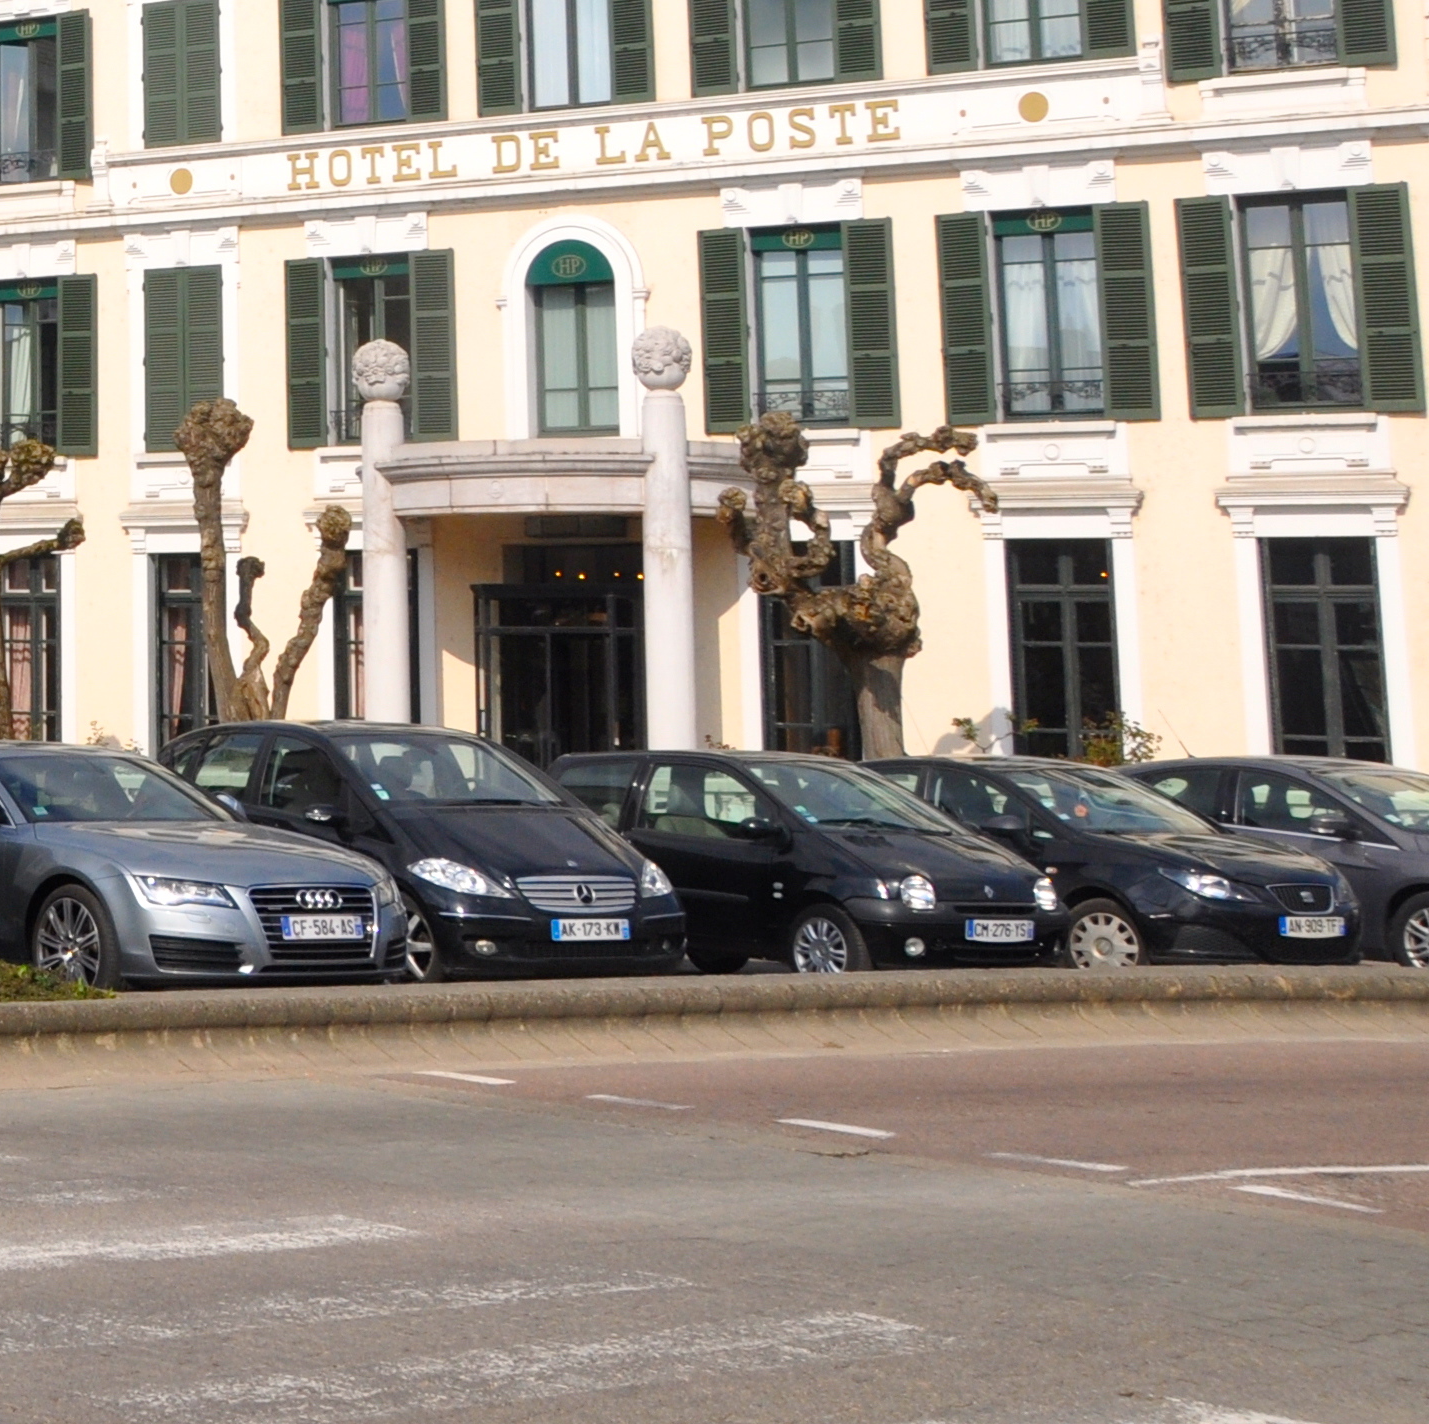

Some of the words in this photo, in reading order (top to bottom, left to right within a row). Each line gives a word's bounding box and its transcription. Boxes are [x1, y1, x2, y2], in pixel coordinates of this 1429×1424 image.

[287, 141, 458, 191] HOTEL
[492, 130, 560, 174] DE
[594, 122, 671, 165] LA
[701, 99, 901, 156] POSTE
[292, 918, 354, 936] CF-584-AS
[561, 922, 620, 937] AK-173-KW
[974, 923, 1027, 937] CM-276-YS
